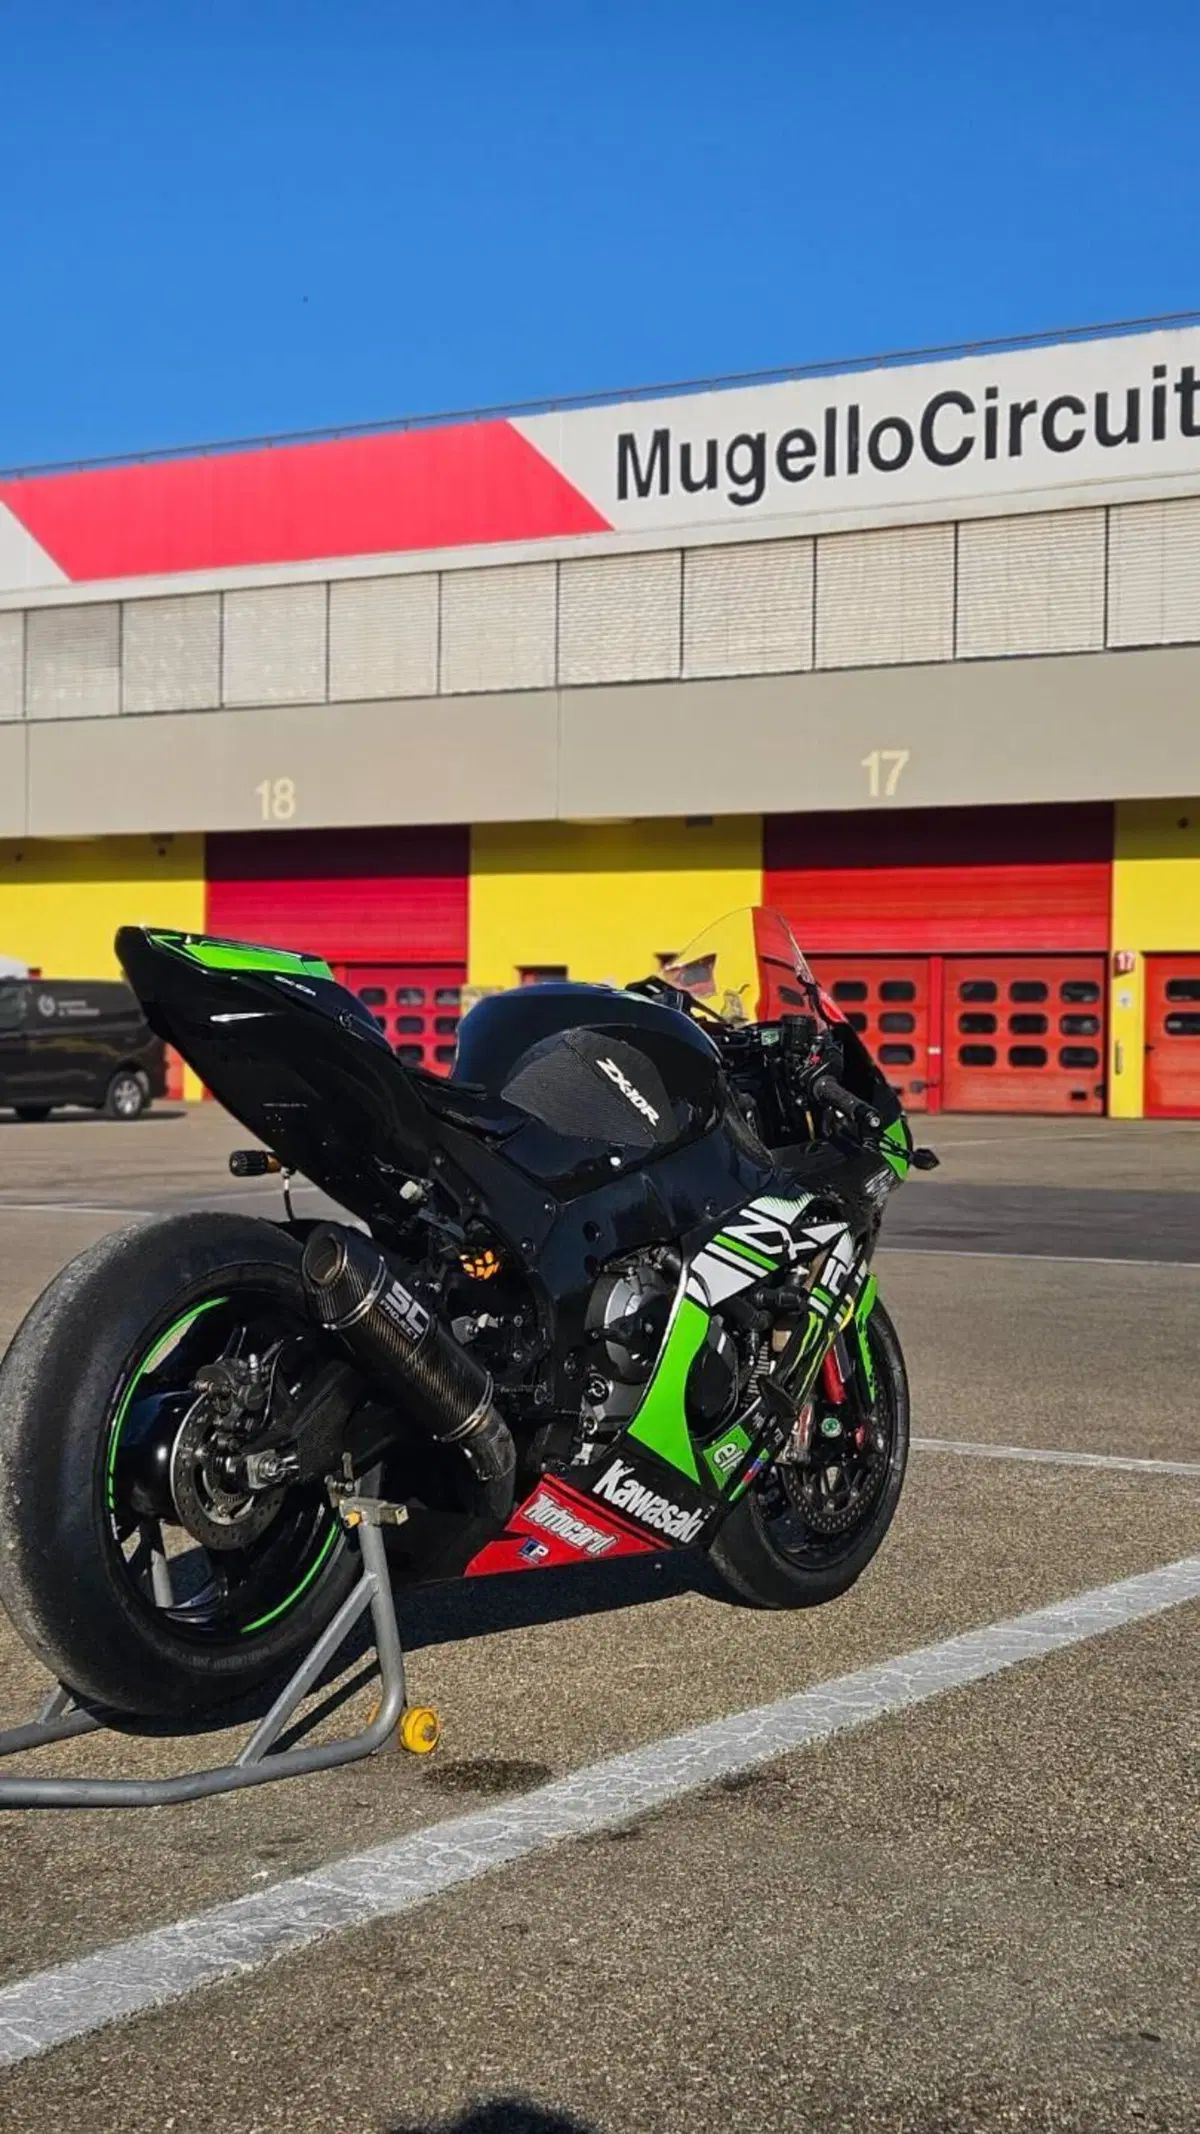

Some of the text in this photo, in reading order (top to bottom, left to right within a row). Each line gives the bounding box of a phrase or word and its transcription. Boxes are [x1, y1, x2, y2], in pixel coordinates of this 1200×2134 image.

[616, 363, 1200, 507] MugelloCircuit
[255, 777, 296, 820] 18
[861, 750, 910, 797] 17
[1116, 951, 1134, 972] 17
[385, 1281, 430, 1335] SC
[592, 1459, 706, 1543] Kawasaki
